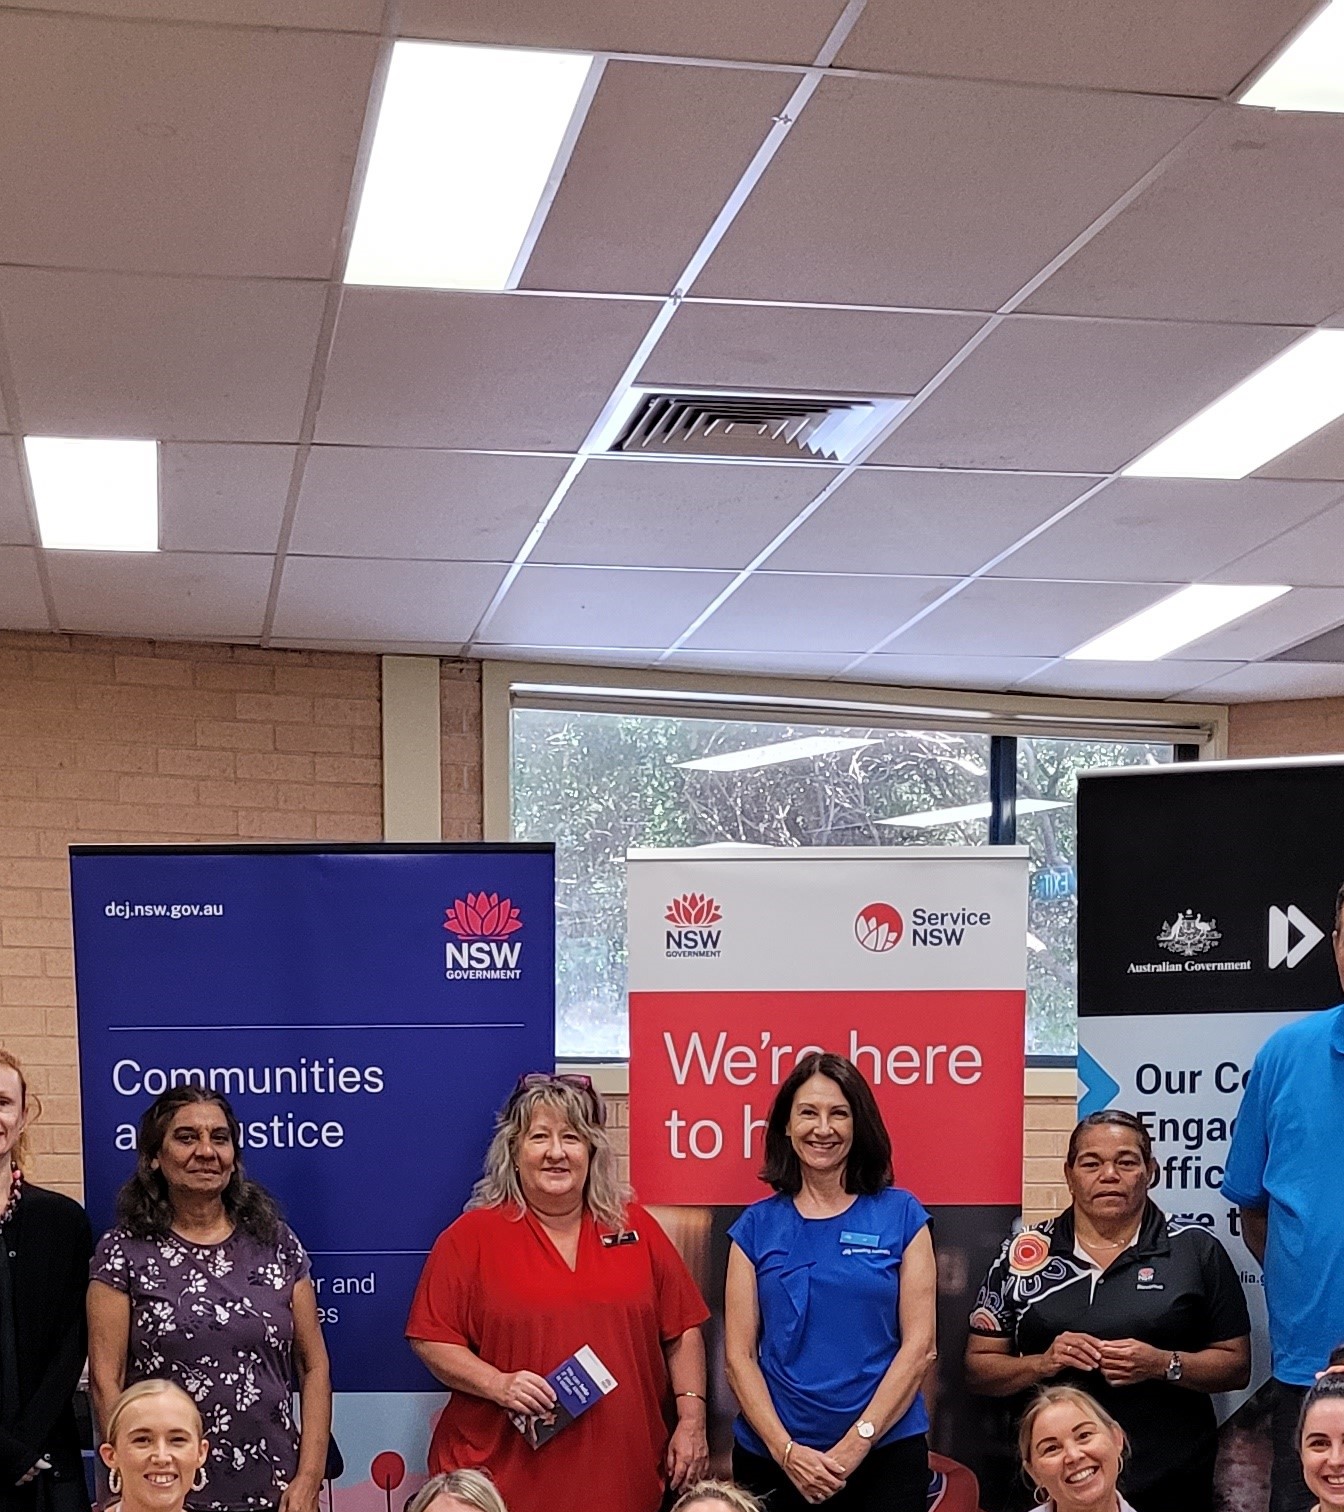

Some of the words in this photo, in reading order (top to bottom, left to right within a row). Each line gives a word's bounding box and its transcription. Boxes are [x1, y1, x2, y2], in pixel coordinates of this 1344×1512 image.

[105, 901, 223, 918] dcj.nsw.gov.au
[912, 907, 991, 927] Service
[665, 929, 721, 949] NSW
[912, 928, 965, 947] NSW
[446, 942, 522, 969] NSW
[665, 950, 721, 958] GOVERNMENT
[446, 970, 521, 980] GOVERNMENT
[1127, 961, 1182, 973] Australian
[1184, 959, 1252, 972] Government
[849, 1030, 982, 1086] here
[112, 1058, 384, 1096] Communities
[1136, 1063, 1202, 1095] Our
[665, 1109, 723, 1160] to
[332, 1272, 375, 1294] and
